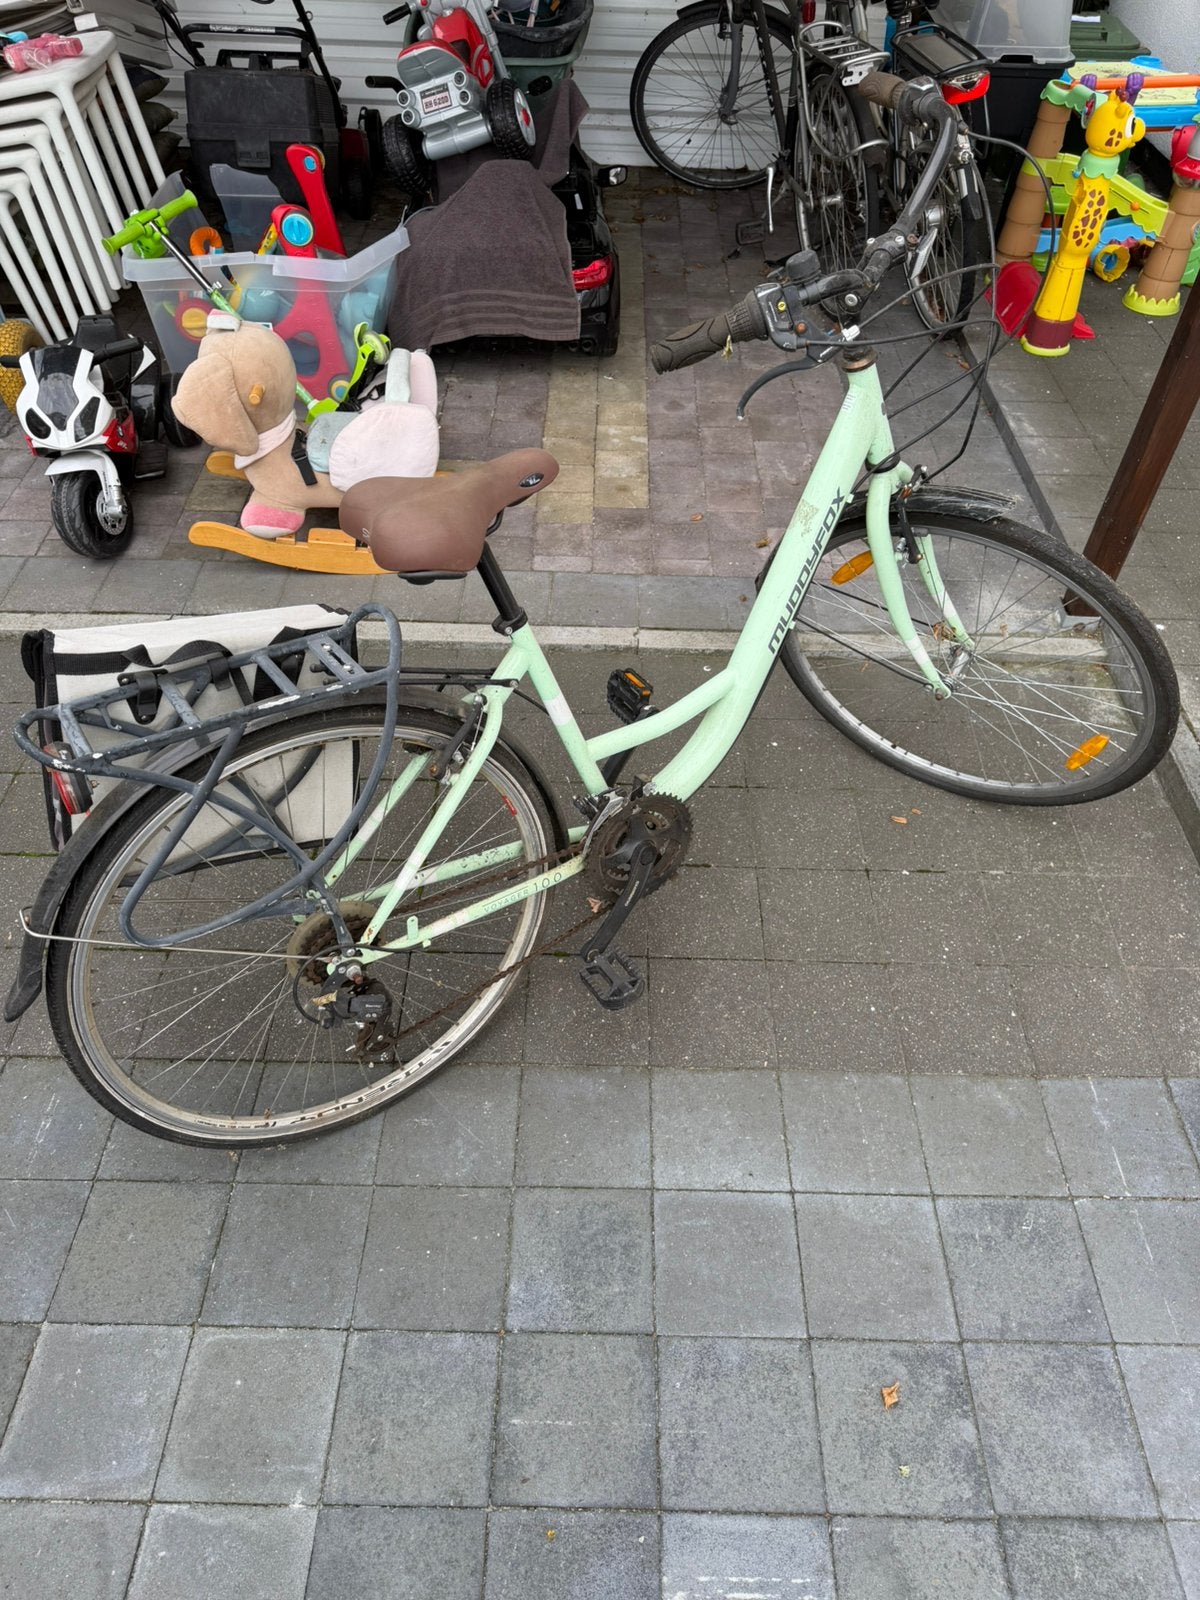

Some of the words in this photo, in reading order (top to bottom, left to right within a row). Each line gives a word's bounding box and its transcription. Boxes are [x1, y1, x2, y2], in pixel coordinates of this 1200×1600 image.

[768, 486, 844, 655] MUDDYFOX
[484, 889, 528, 913] VOYAGER
[534, 872, 562, 892] 100
